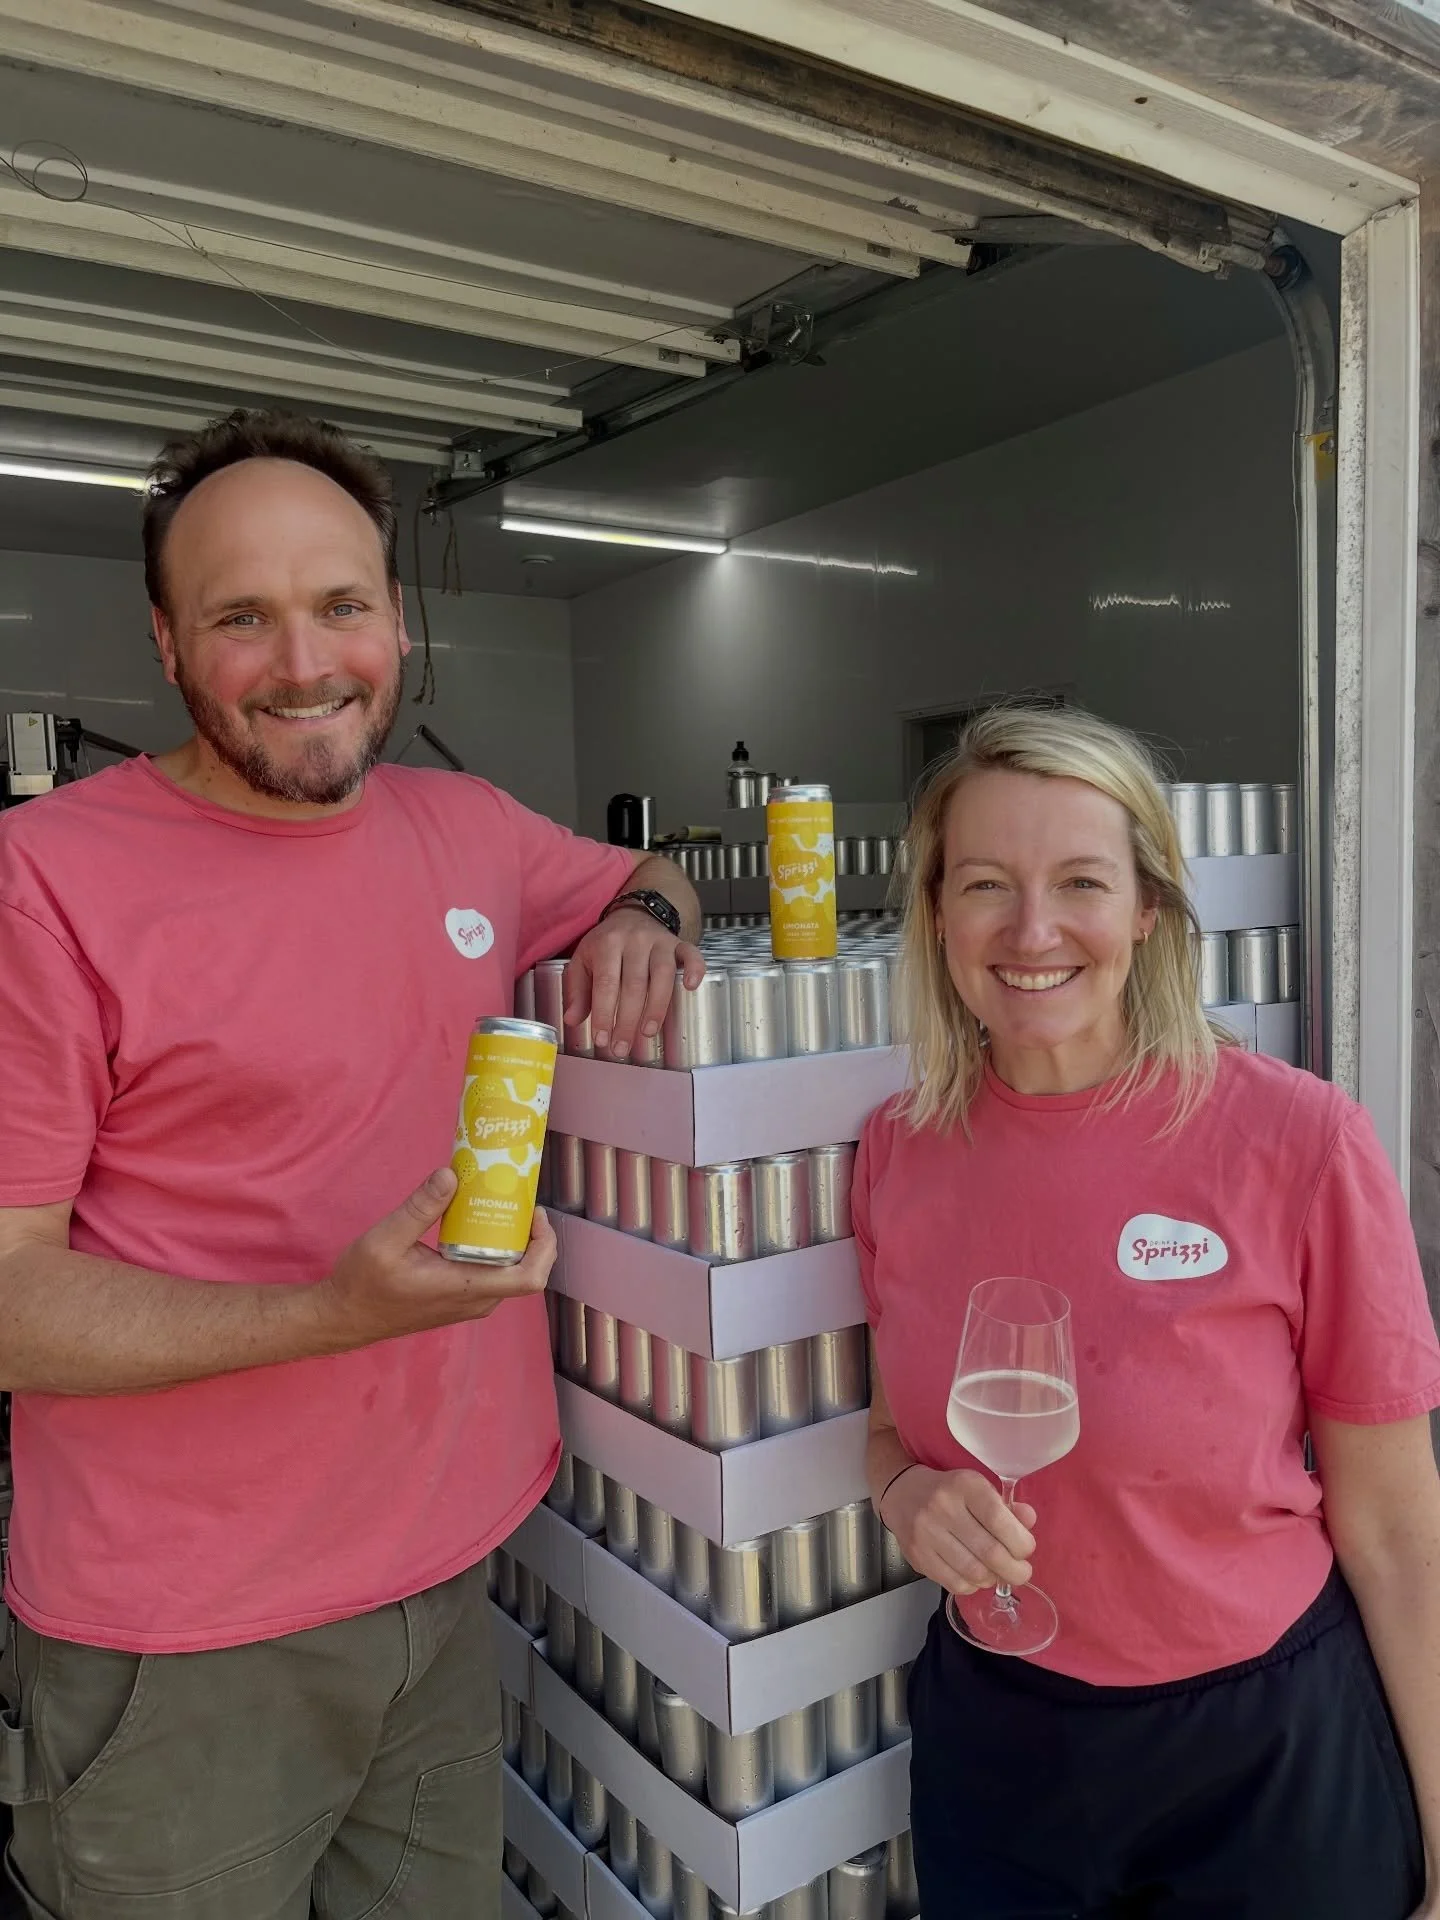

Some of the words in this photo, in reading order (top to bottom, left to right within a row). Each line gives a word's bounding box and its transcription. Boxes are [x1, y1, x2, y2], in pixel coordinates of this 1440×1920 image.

[777, 856, 818, 881] Sprizzi
[474, 1113, 532, 1139] Sprizzi
[1131, 1237, 1209, 1266] Sprizzi
